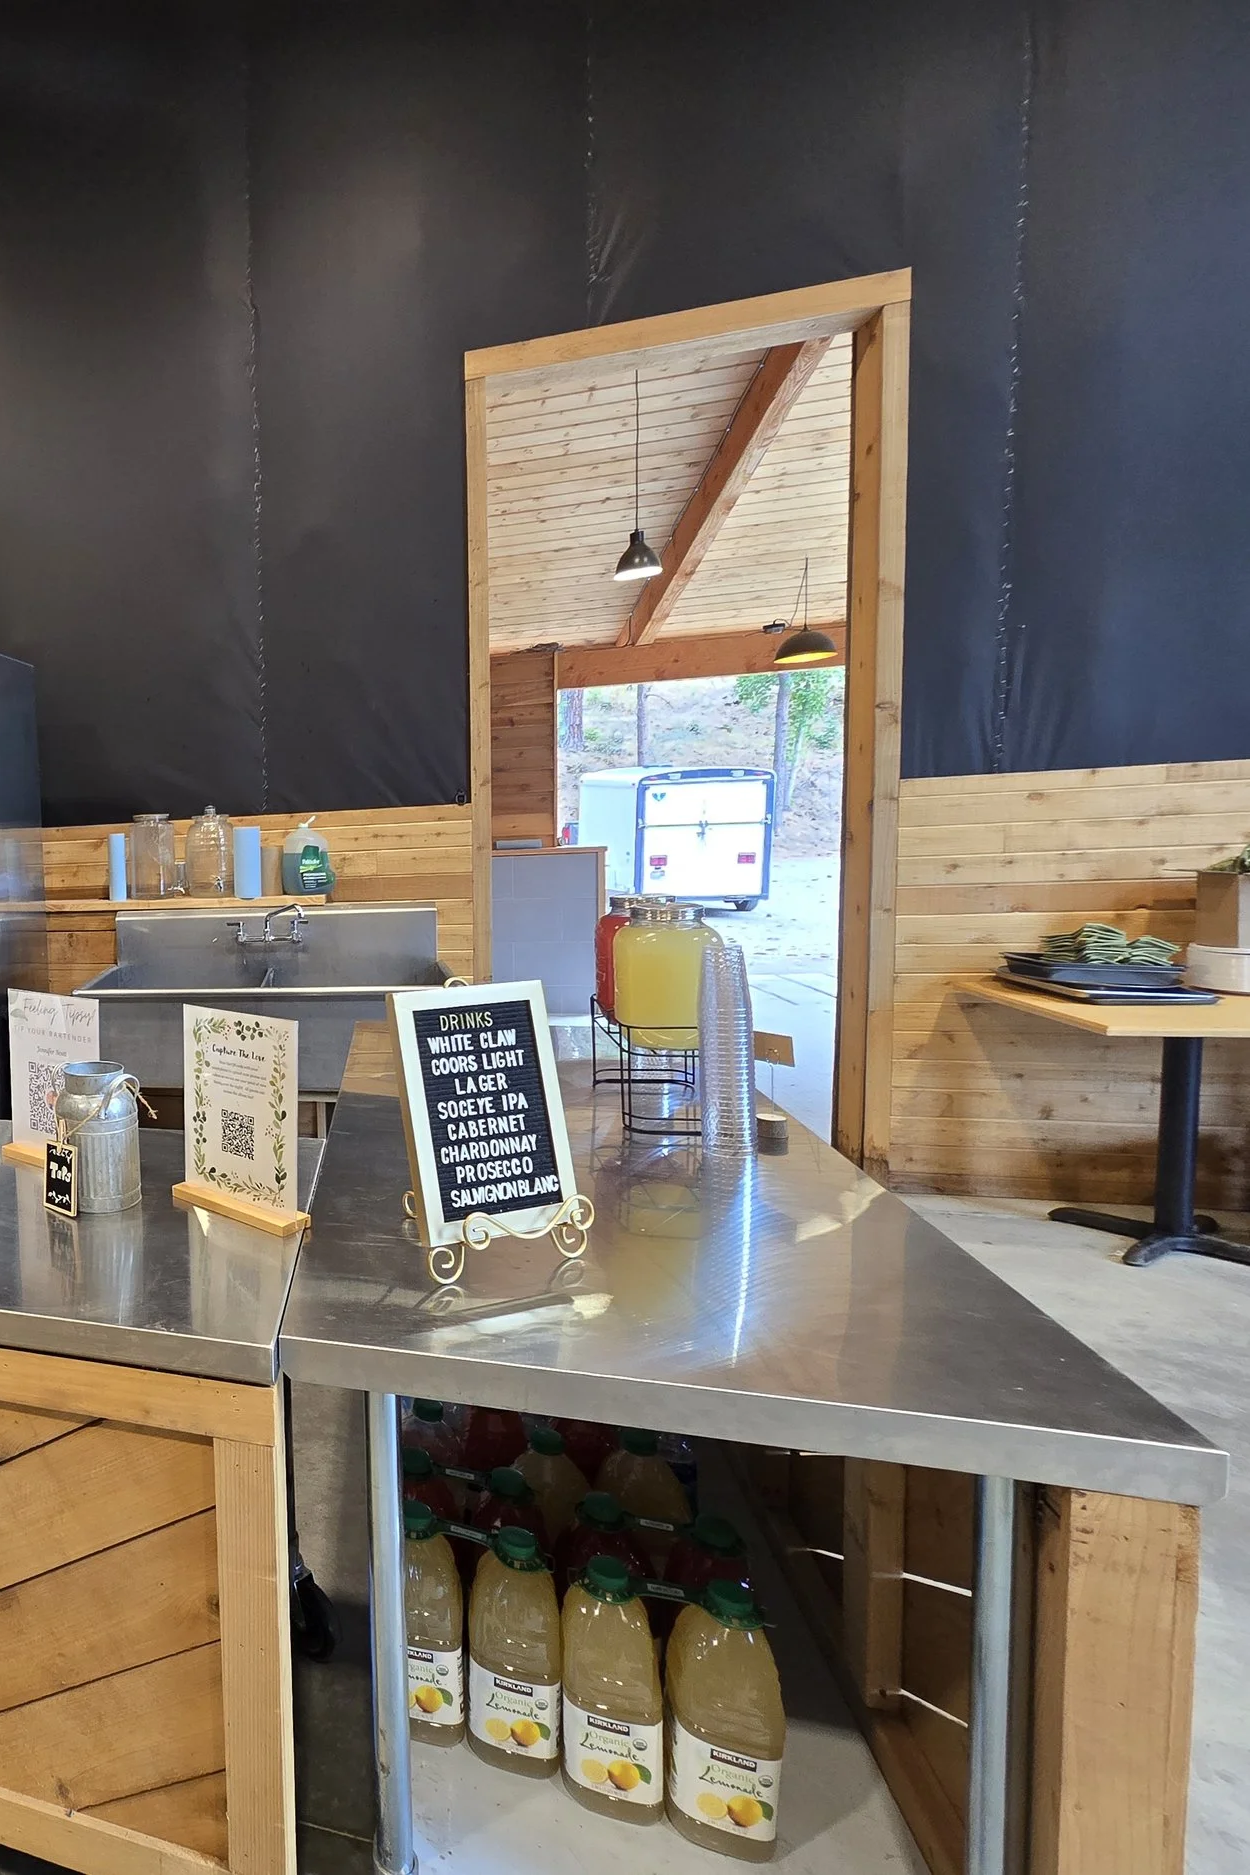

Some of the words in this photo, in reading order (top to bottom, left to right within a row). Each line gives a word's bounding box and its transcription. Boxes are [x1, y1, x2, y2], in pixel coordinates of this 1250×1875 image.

[23, 999, 59, 1026] Feeling
[440, 1011, 494, 1032] DRINKS
[27, 1028, 46, 1036] YOUR
[49, 1030, 92, 1044] BARTENDER
[427, 1033, 474, 1054] WHITE
[479, 1028, 517, 1049] CLAW
[212, 1043, 236, 1056] Capture
[239, 1049, 249, 1059] The
[252, 1051, 265, 1062] Love
[431, 1055, 478, 1076] COORS
[481, 1049, 524, 1070] LIGHT
[454, 1072, 508, 1095] LAGER
[437, 1096, 496, 1120] SOCEYE
[501, 1092, 528, 1112] IPA
[447, 1114, 525, 1141] CABERNET
[440, 1133, 537, 1165] CHARDONNAY
[455, 1156, 534, 1185] PROSECCO
[495, 1678, 532, 1694] KIRKLAND
[485, 1692, 540, 1721] Lemonade
[495, 1691, 534, 1707] Organic
[589, 1716, 629, 1733] KIRKLAND
[579, 1732, 640, 1762] Lemonade
[589, 1730, 630, 1748] Organic
[712, 1750, 756, 1768] KIRKLAND
[698, 1765, 763, 1799] Lemonade
[711, 1764, 755, 1784] Organic
